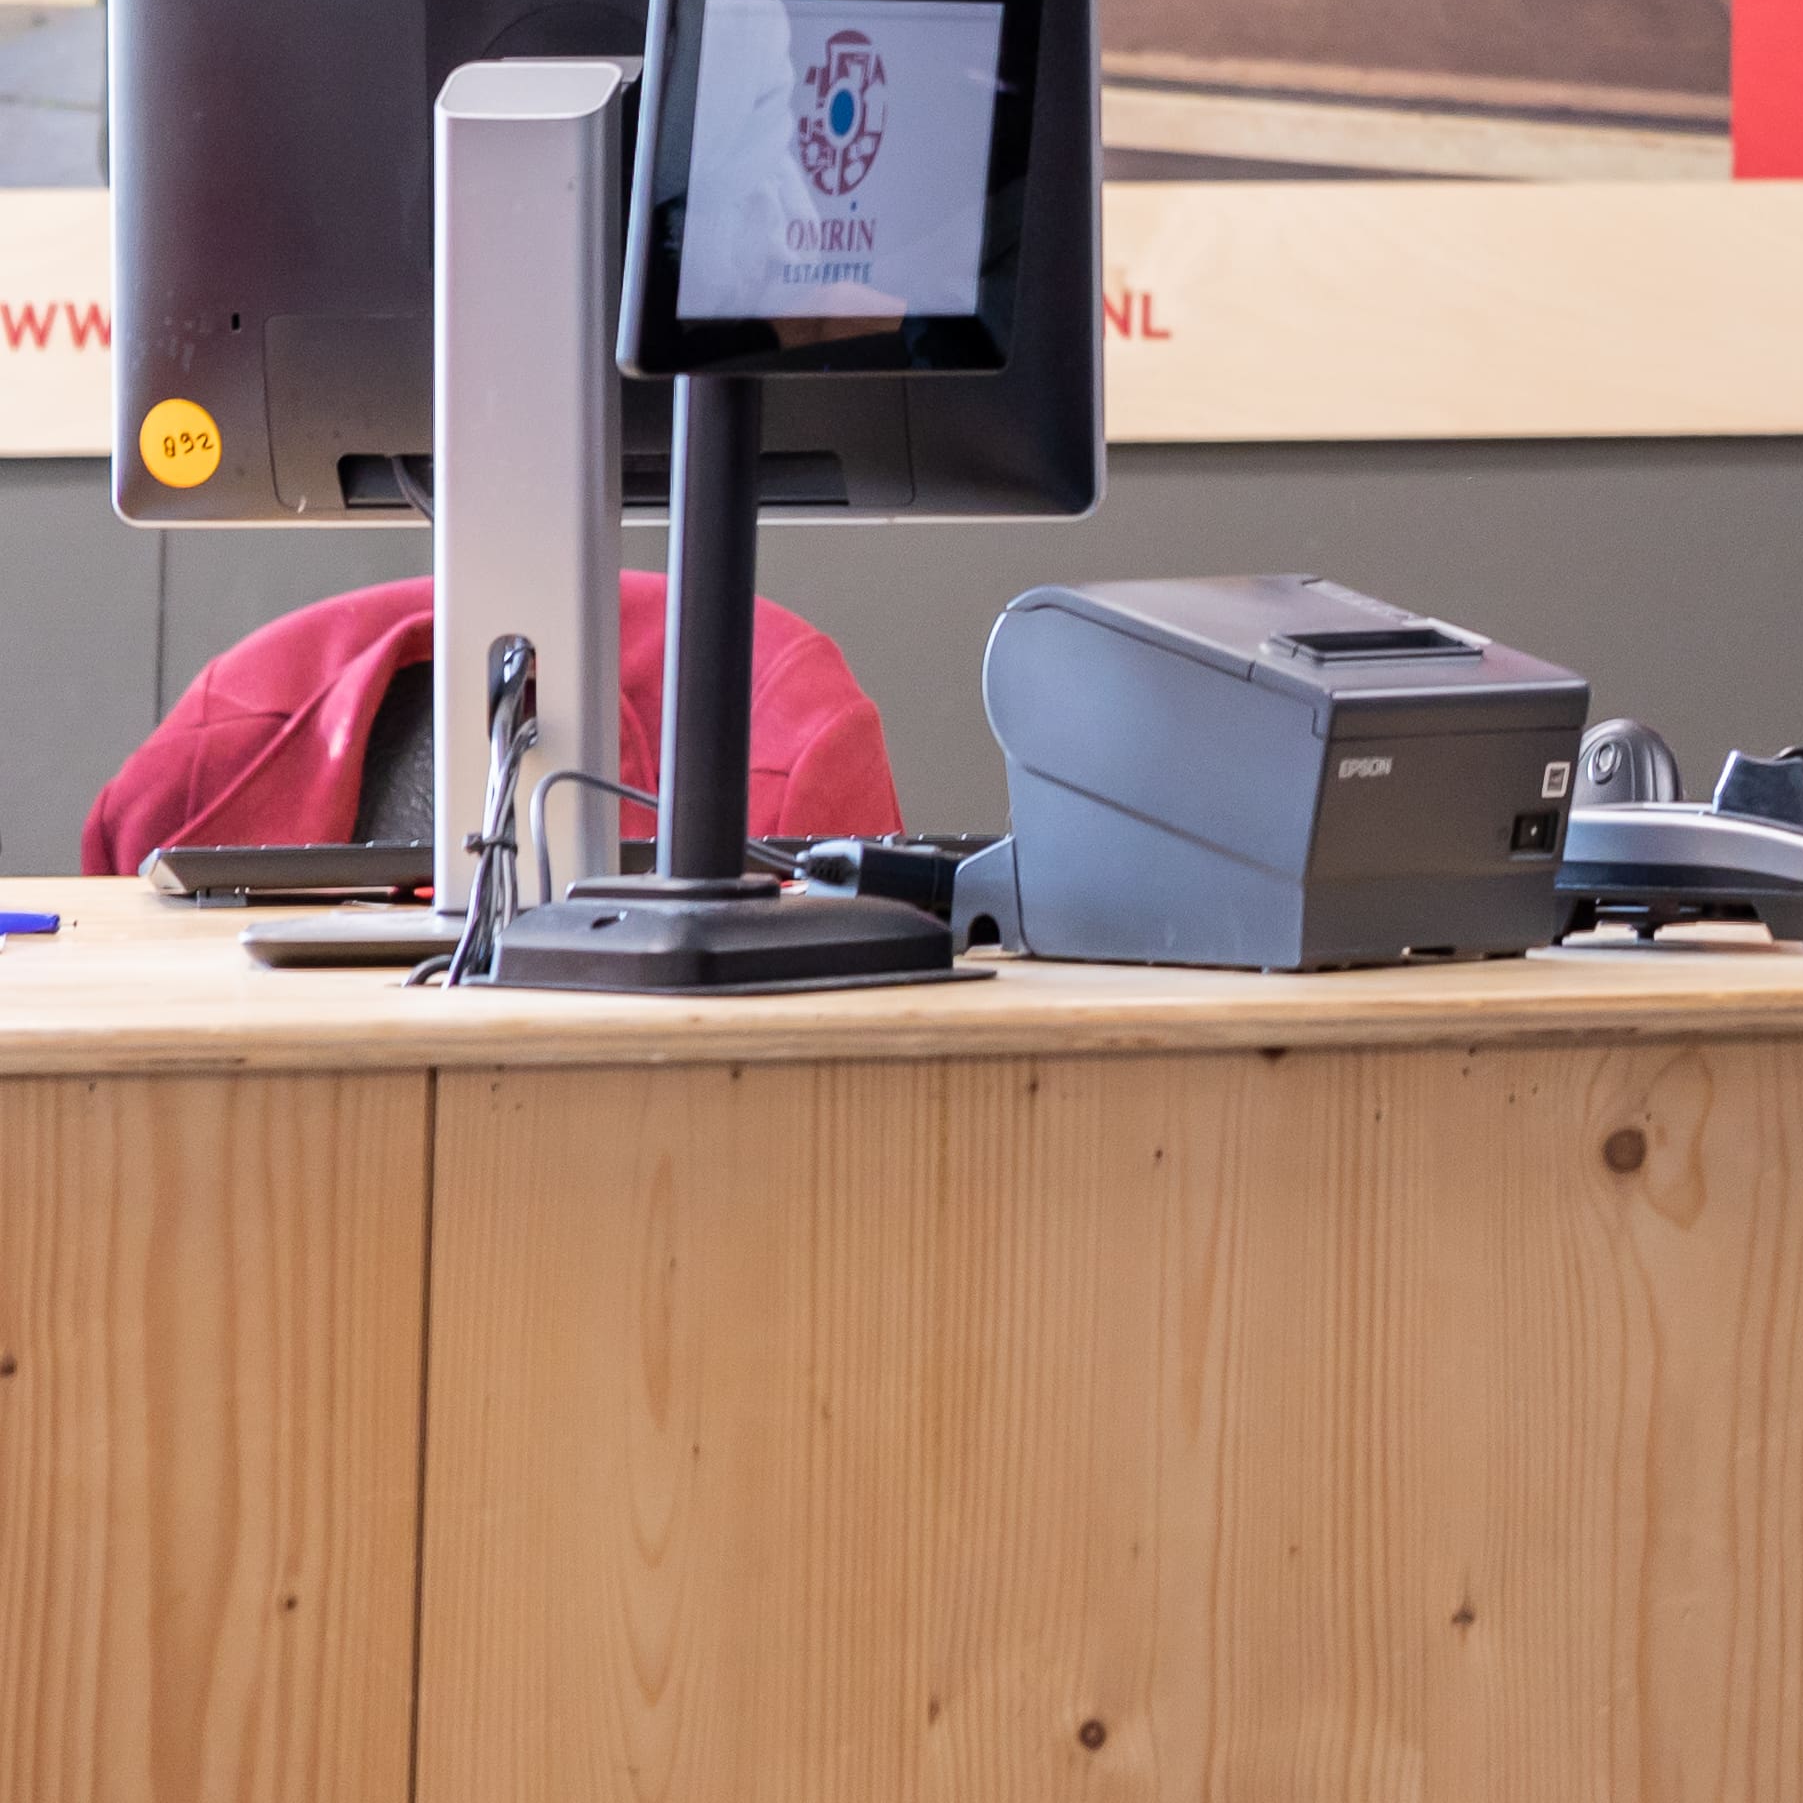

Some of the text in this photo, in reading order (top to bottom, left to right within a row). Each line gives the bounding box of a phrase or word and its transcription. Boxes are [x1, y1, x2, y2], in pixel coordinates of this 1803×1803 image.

[0, 292, 1173, 353] WW NL
[1338, 757, 1393, 780] EPSON
